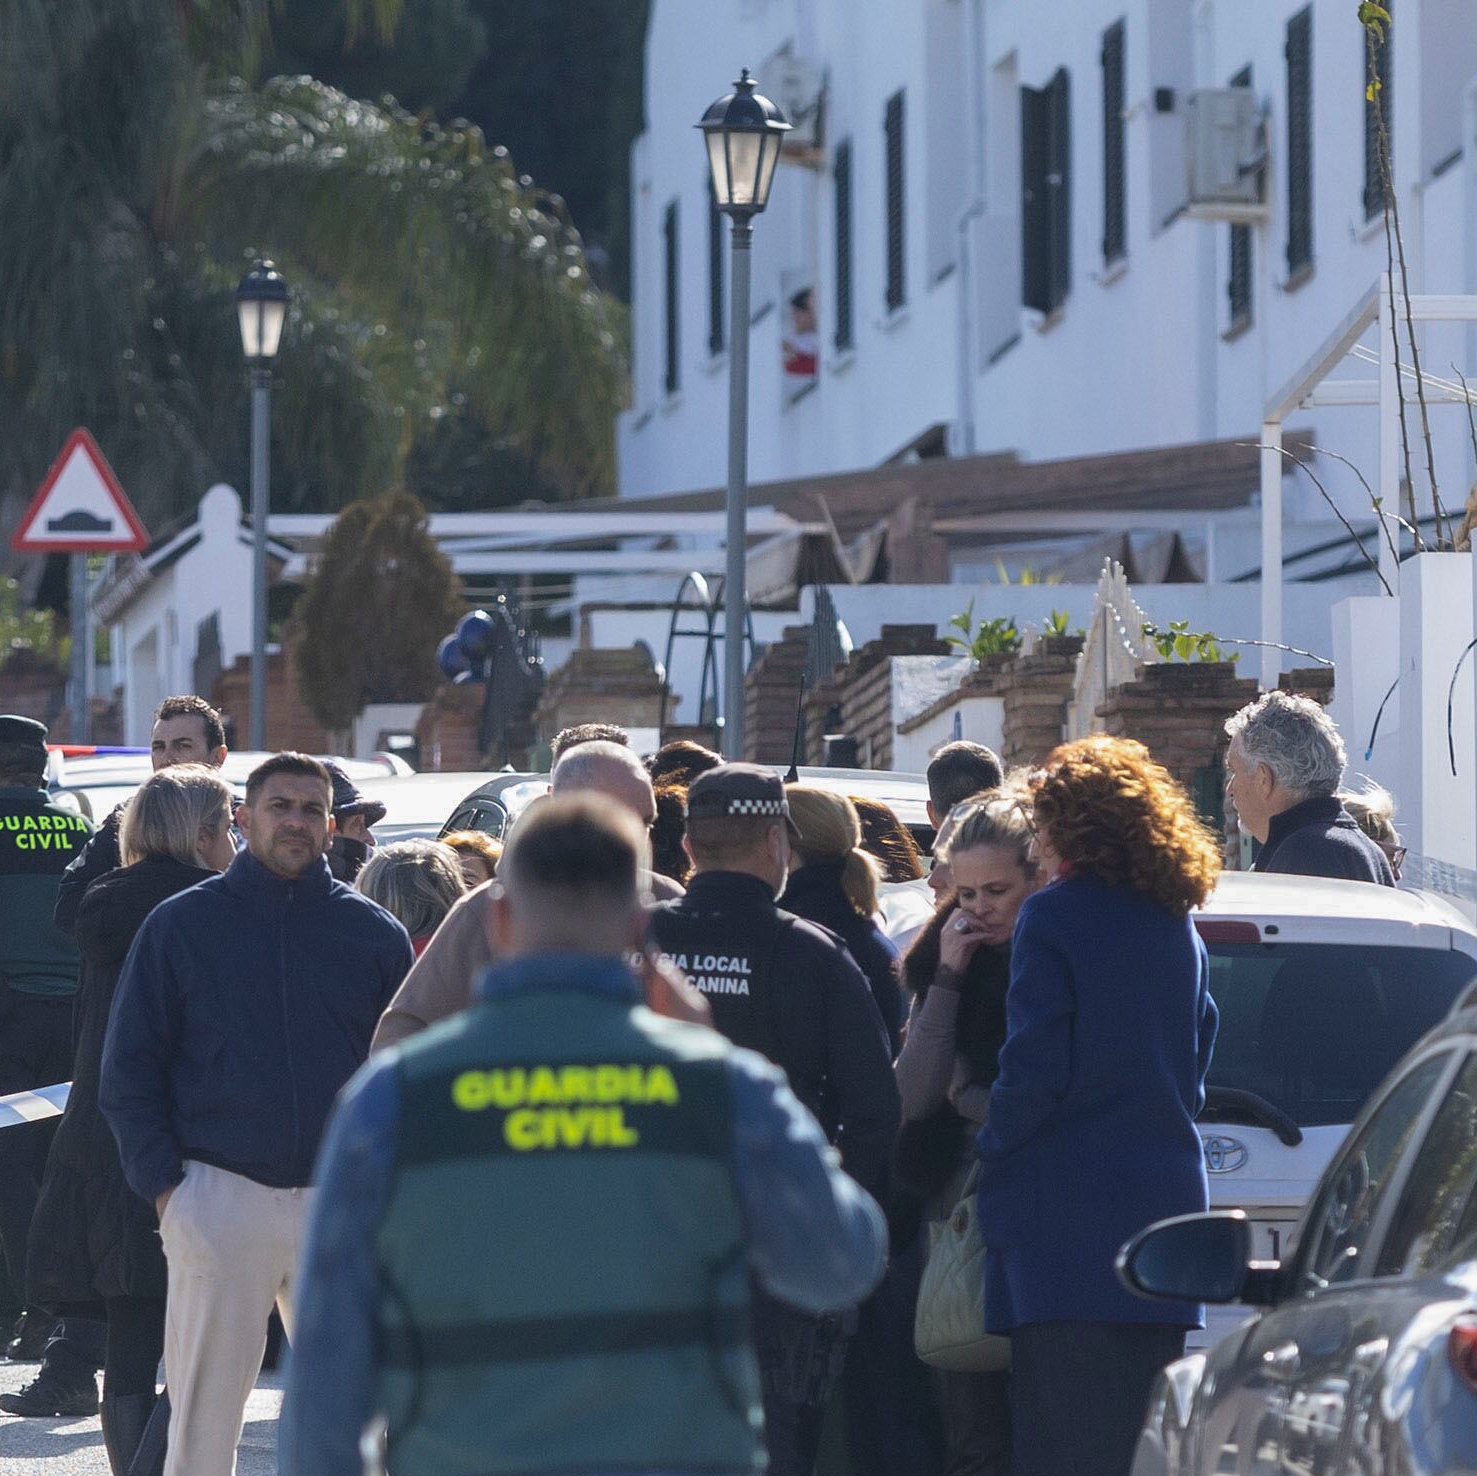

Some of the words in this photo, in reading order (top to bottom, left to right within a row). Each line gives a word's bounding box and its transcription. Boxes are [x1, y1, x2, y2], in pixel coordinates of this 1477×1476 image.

[15, 833, 73, 849] CIVIL
[693, 955, 752, 973] LOCAL
[684, 975, 750, 996] CANINA
[452, 1064, 680, 1112] GUARDIA
[503, 1106, 640, 1151] CIVIL
